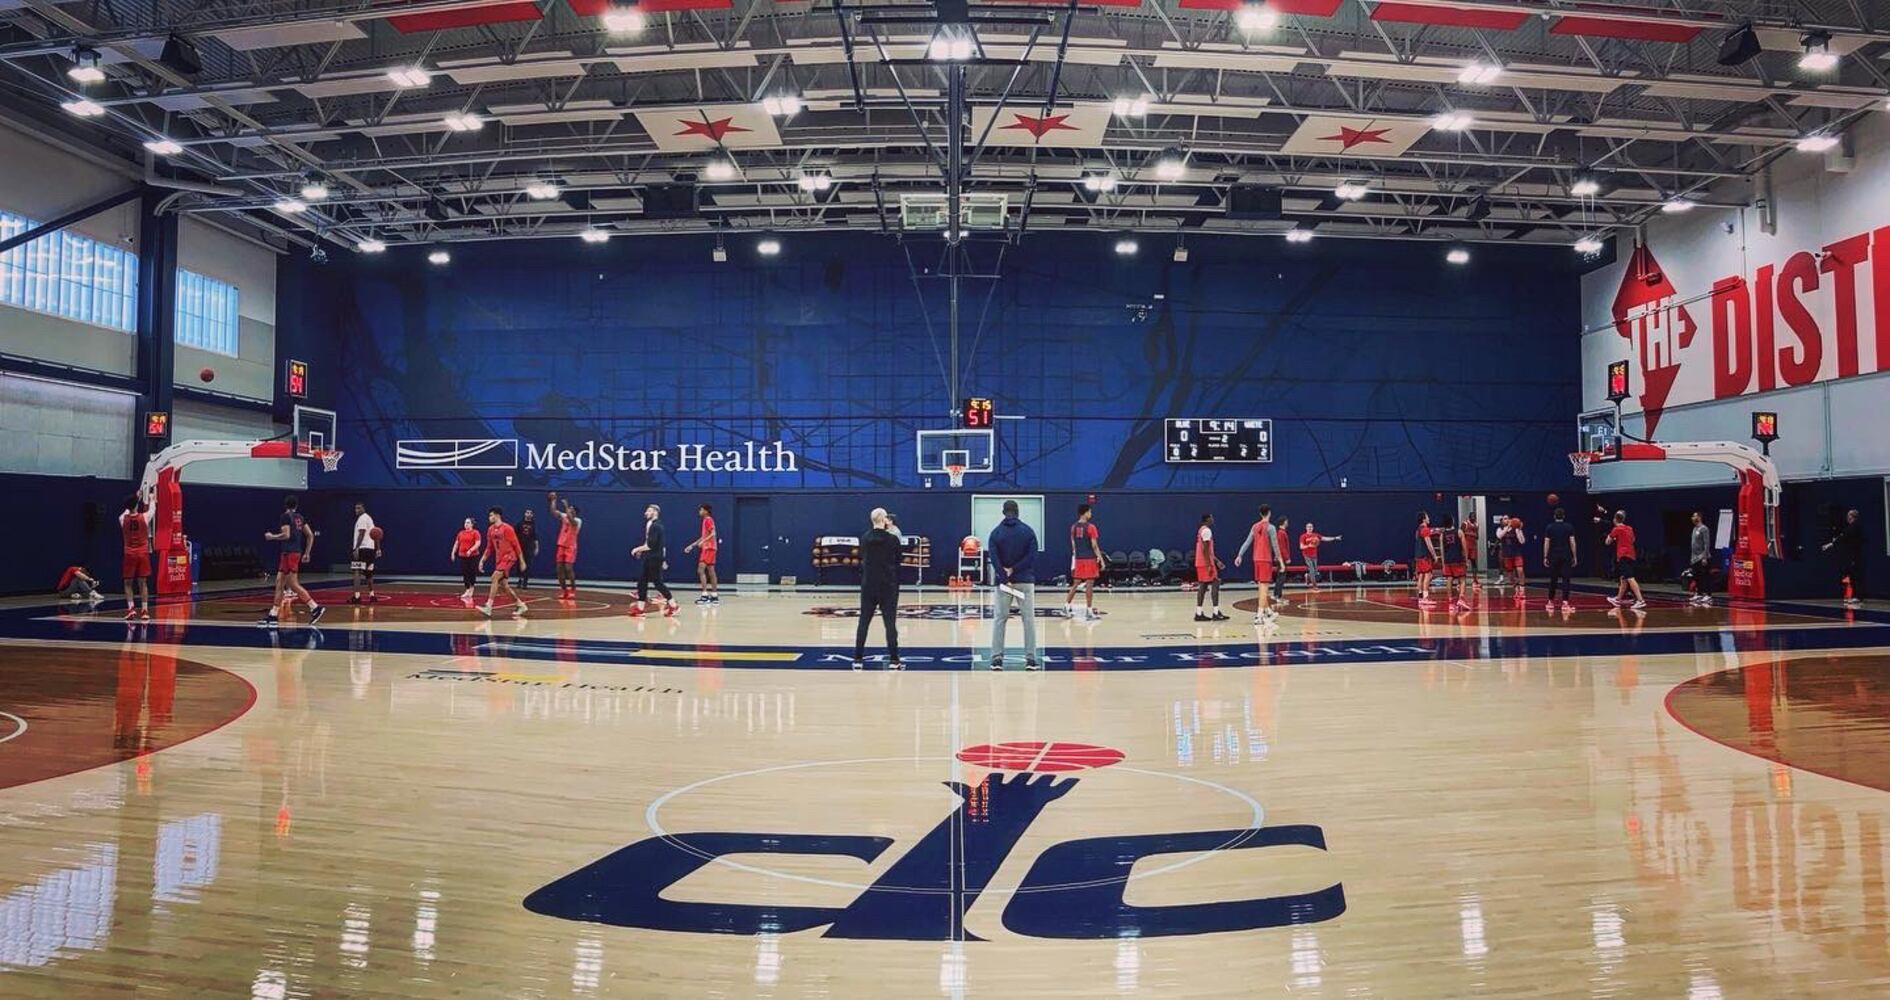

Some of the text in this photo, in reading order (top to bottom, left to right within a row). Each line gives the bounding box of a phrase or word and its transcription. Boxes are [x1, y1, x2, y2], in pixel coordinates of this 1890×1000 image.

[1712, 226, 1890, 400] DIST
[968, 409, 988, 425] 51
[1180, 430, 1188, 442] 0
[1259, 431, 1268, 442] 0
[525, 440, 799, 473] MedStar Health
